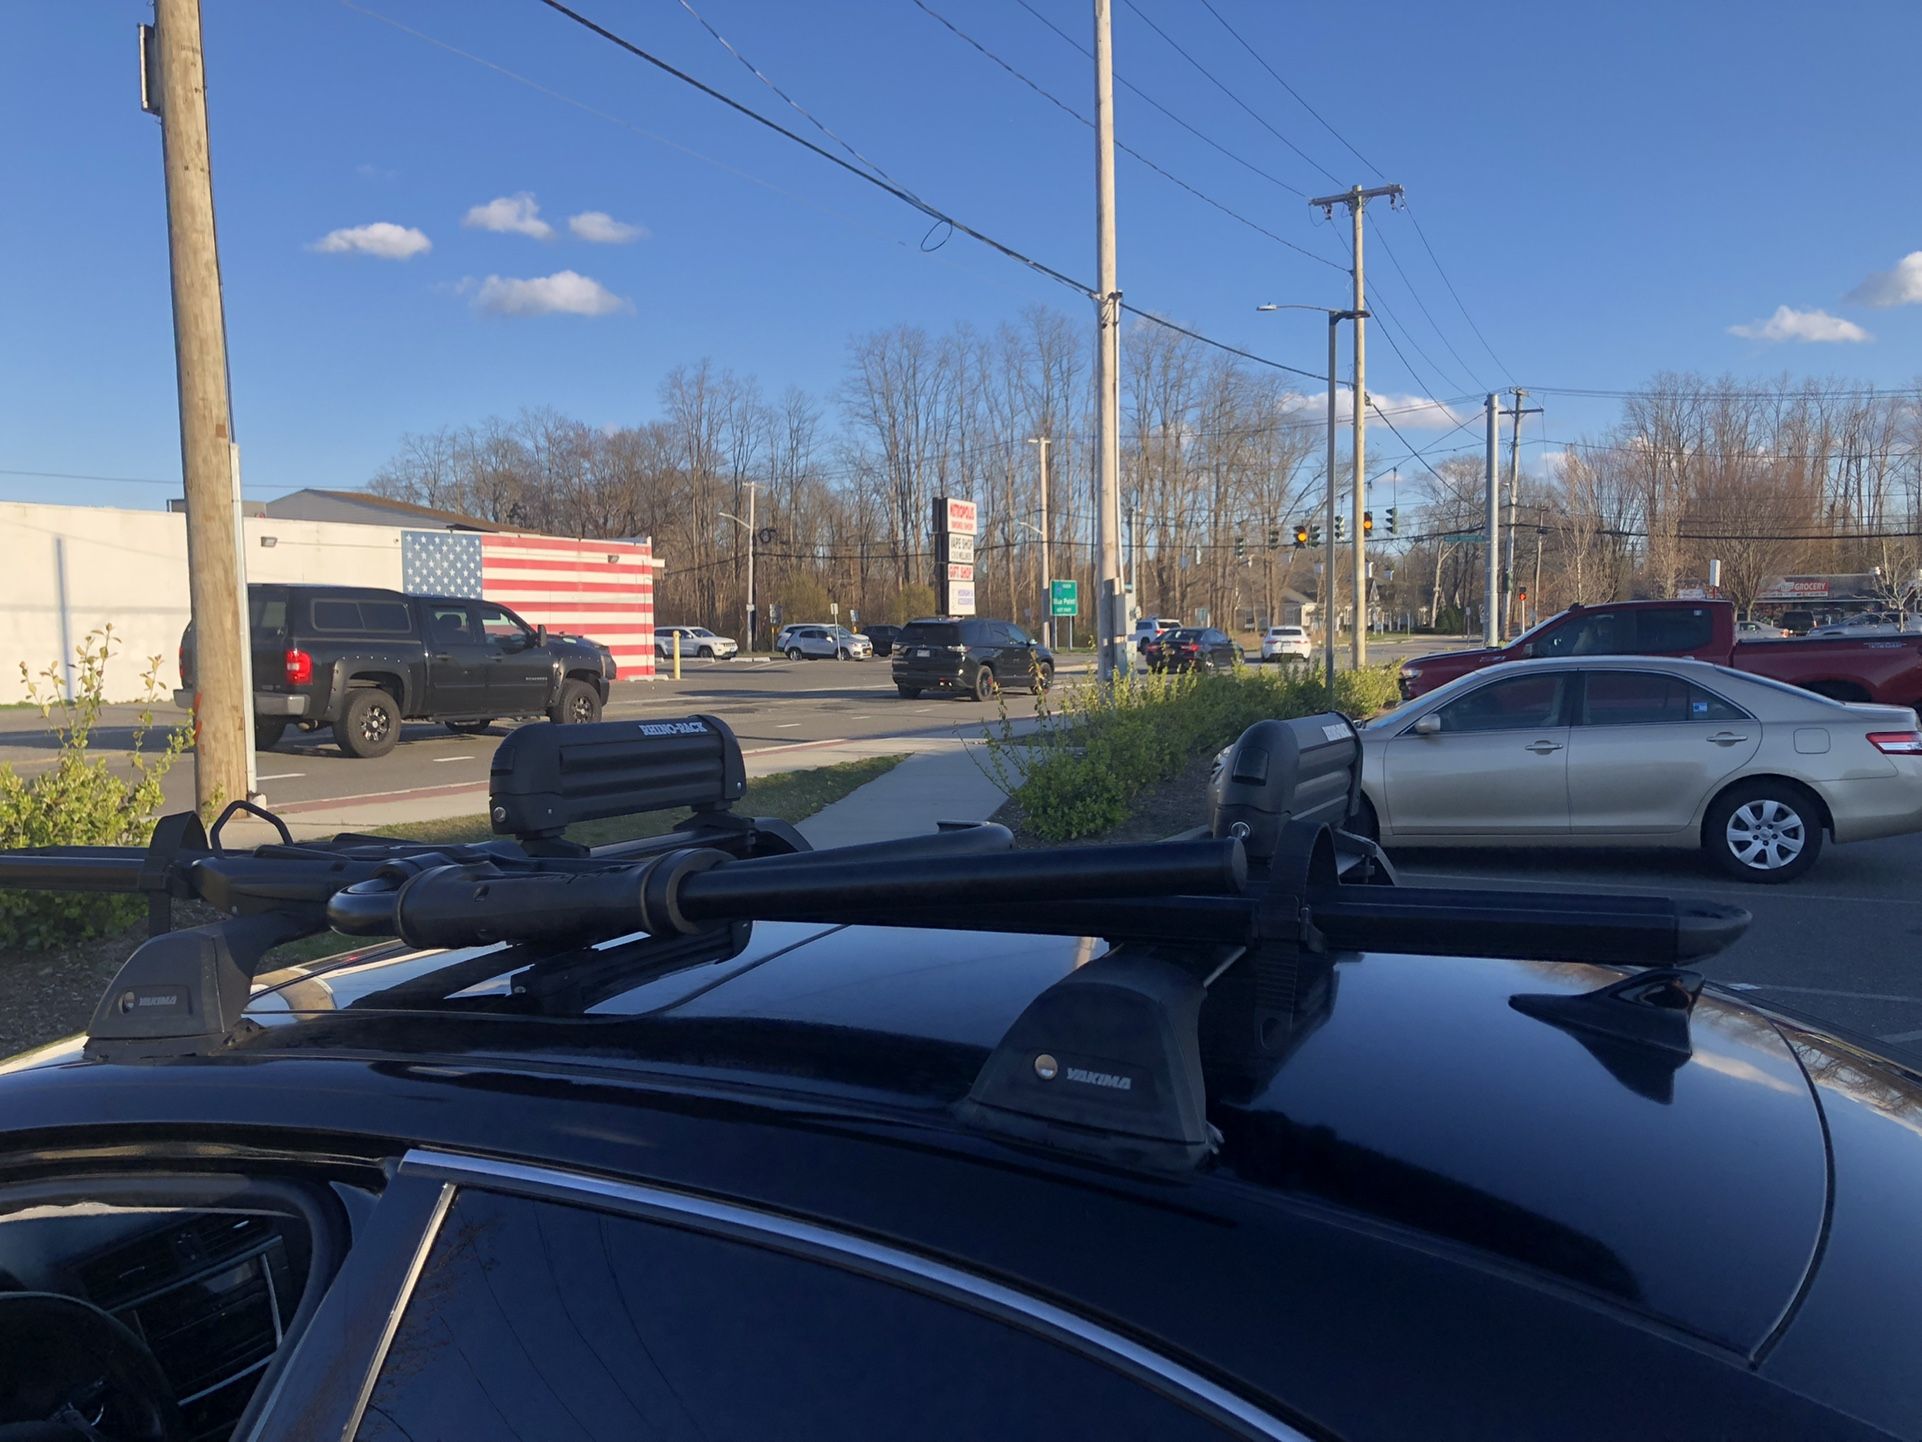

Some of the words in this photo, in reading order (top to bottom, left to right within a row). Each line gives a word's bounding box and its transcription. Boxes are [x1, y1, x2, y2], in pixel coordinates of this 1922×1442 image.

[1794, 582, 1827, 592] GROCERY
[638, 721, 708, 736] RHINO-RACK
[1066, 1067, 1132, 1090] YAKIMA
